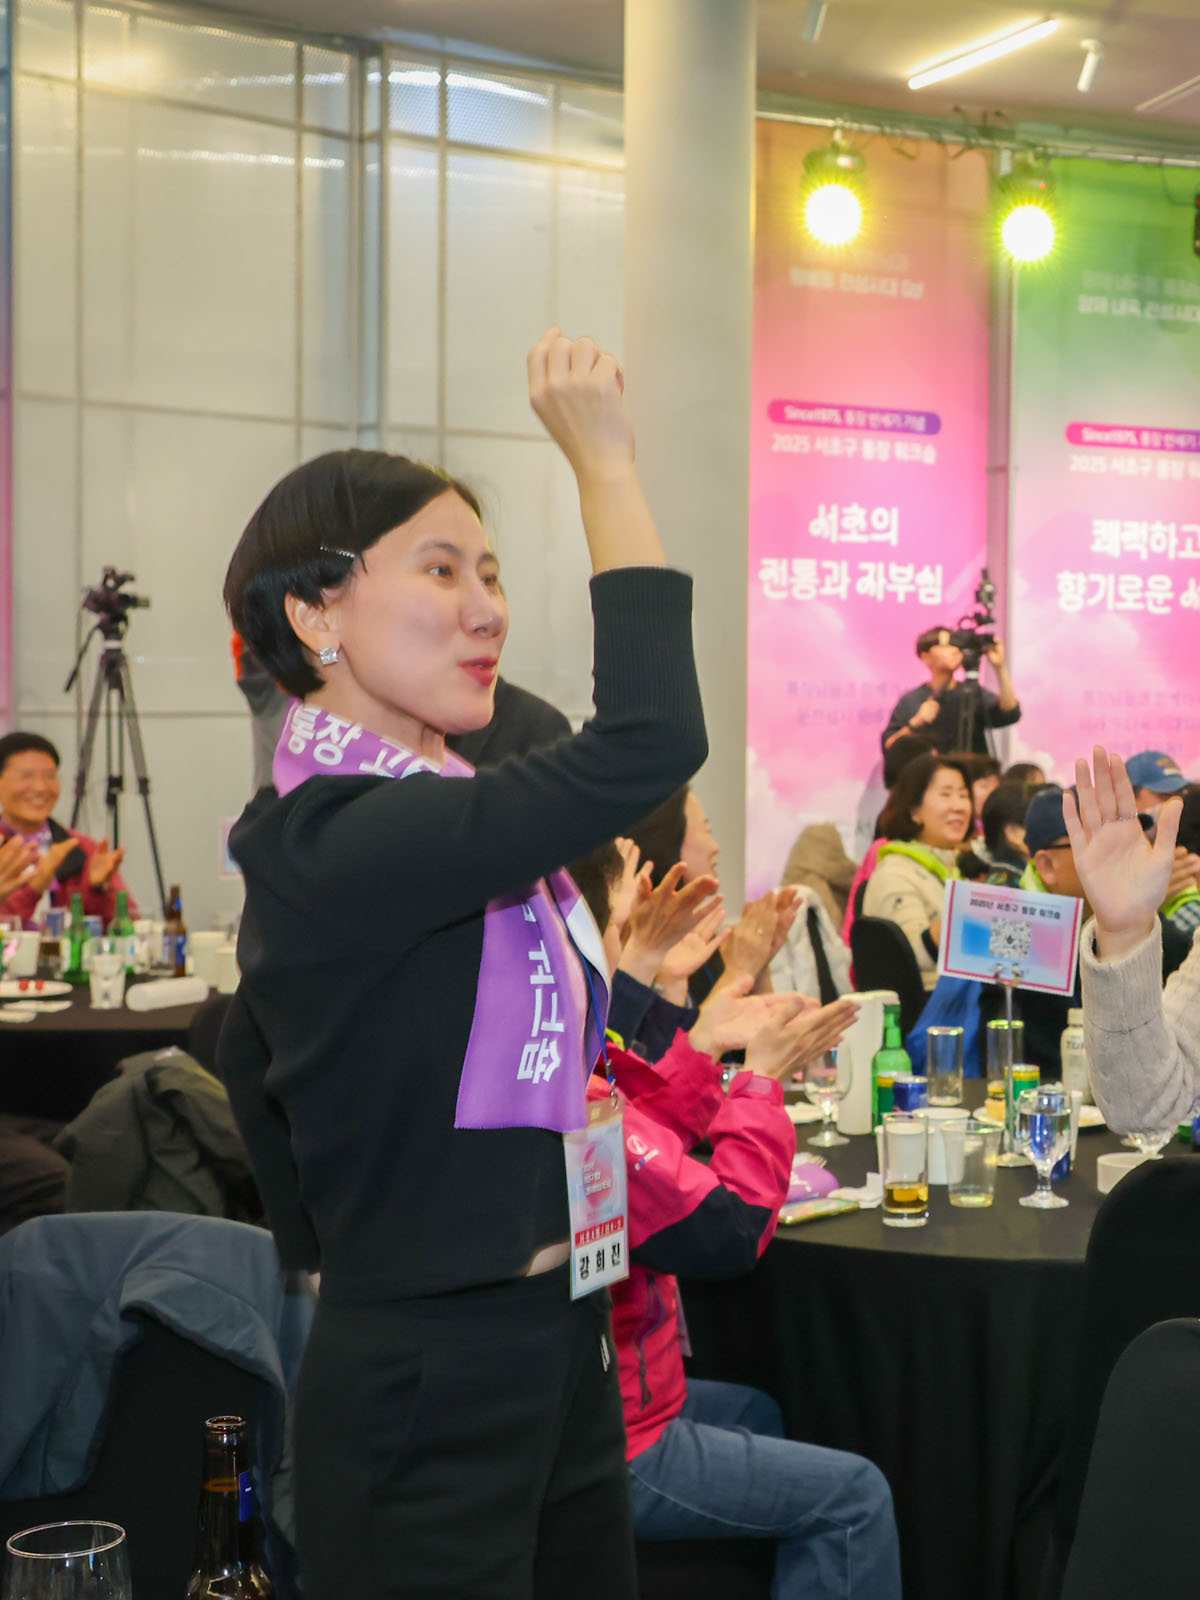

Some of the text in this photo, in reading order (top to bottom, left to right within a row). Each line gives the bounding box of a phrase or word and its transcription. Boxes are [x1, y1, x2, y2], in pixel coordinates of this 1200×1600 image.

[772, 433, 937, 466] 2025 서초구 통장 워크숍
[1069, 454, 1107, 474] 2025
[1110, 456, 1153, 478] 서초구
[1156, 458, 1184, 480] 통장
[808, 502, 898, 547] 서초의
[758, 558, 943, 605] 전통과 자부심
[1056, 570, 1175, 614] 향기로운
[287, 705, 363, 765] 통장
